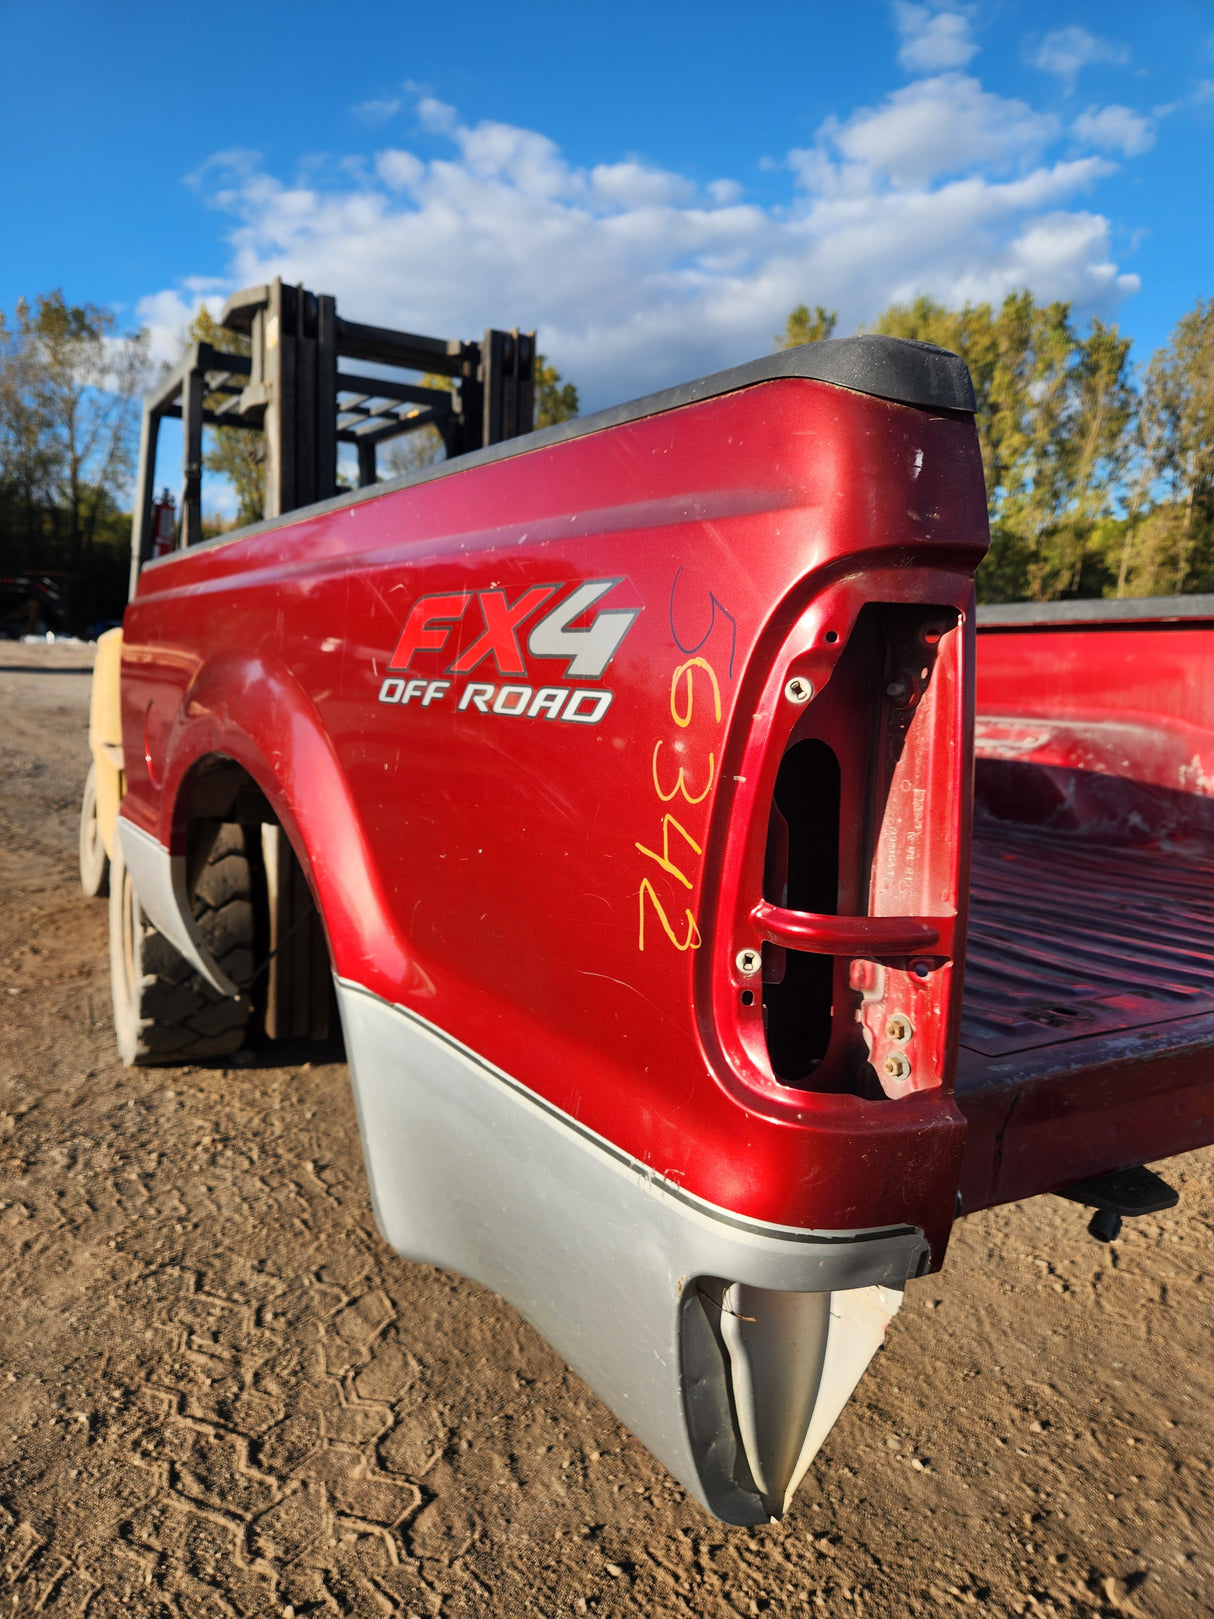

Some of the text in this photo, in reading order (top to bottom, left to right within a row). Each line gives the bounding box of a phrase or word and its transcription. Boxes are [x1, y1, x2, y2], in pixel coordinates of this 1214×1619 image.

[386, 577, 645, 680] FX4
[378, 678, 614, 725] OFF ROAD
